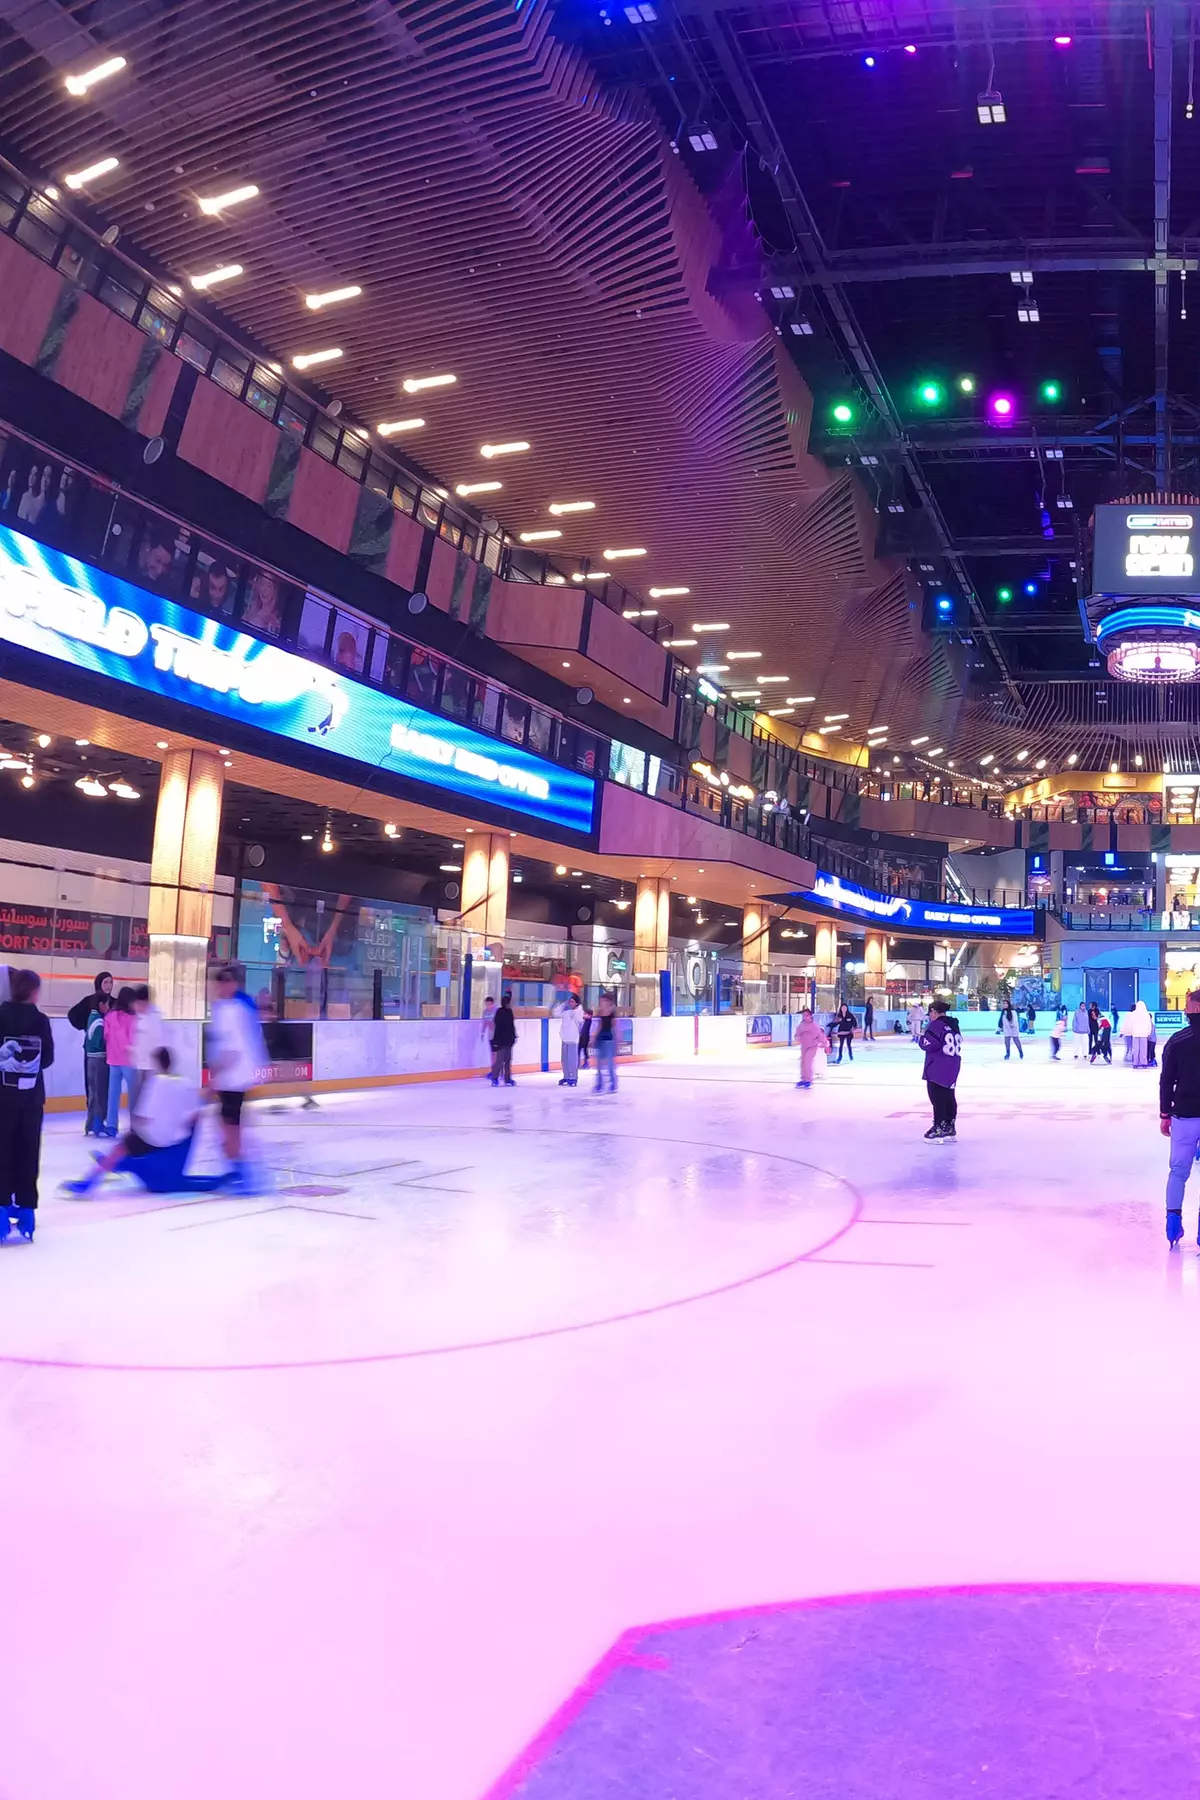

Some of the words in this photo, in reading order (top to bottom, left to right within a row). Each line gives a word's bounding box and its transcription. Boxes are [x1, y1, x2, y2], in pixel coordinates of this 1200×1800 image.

[0, 908, 47, 929] سوسايت
[0, 933, 30, 950] ORT
[942, 1032, 963, 1057] 88
